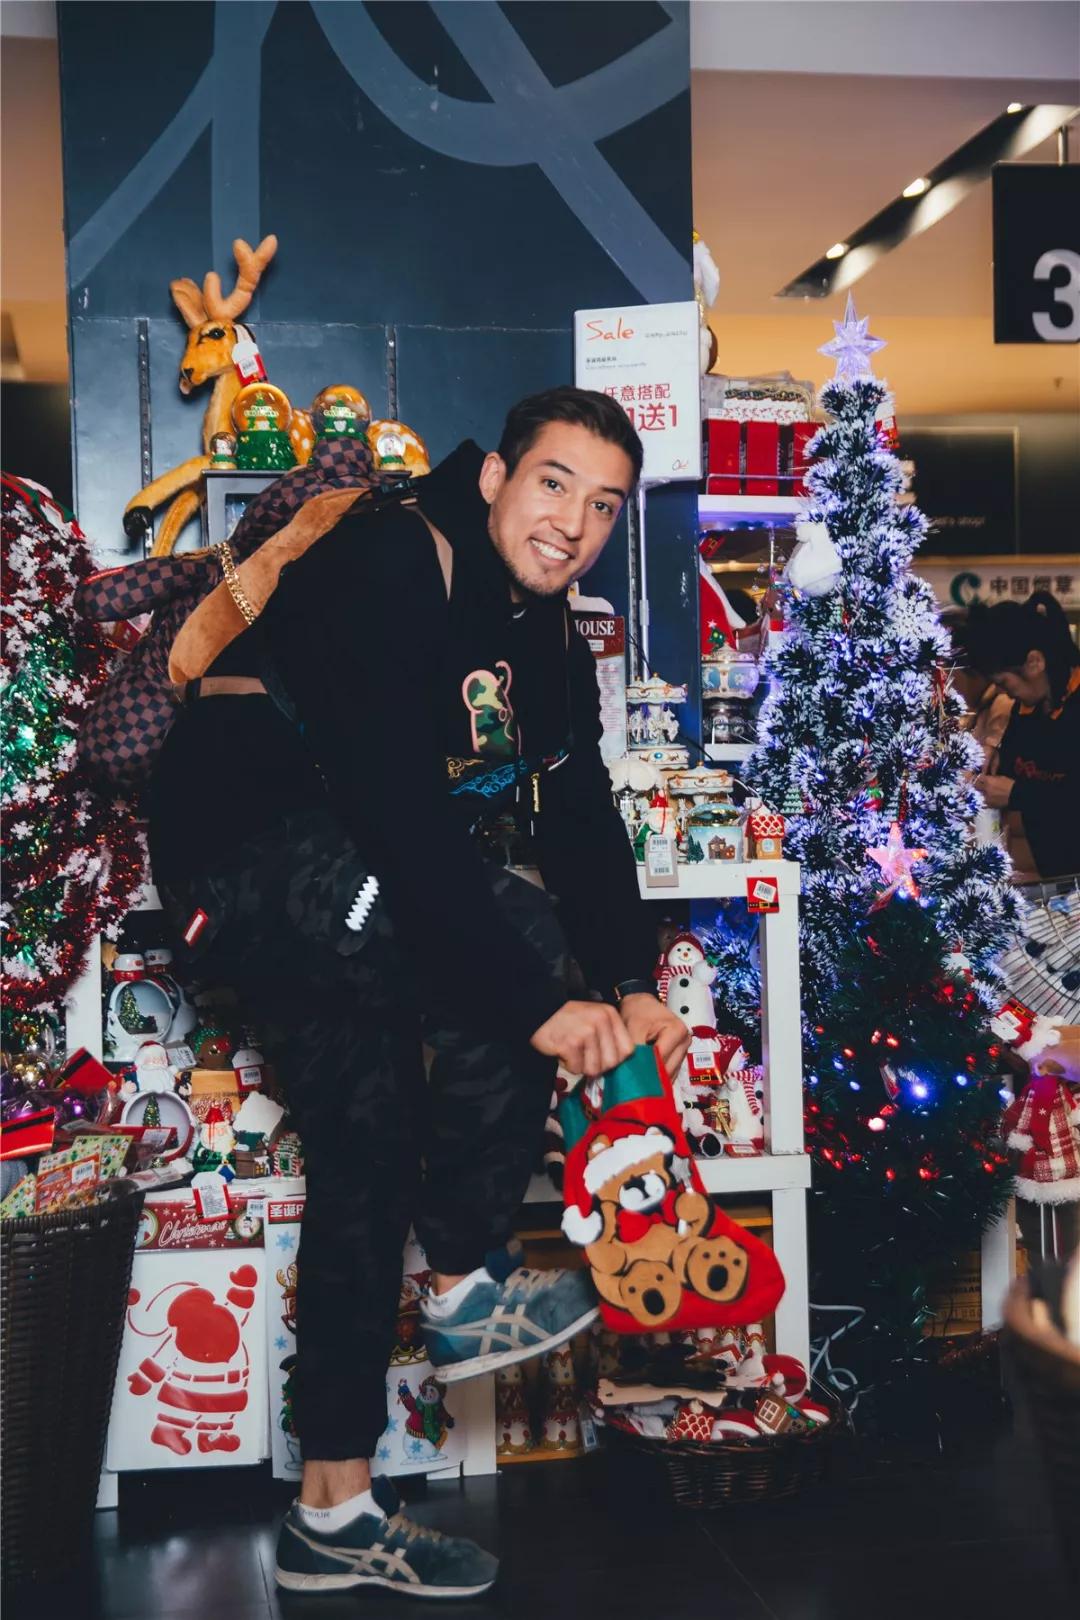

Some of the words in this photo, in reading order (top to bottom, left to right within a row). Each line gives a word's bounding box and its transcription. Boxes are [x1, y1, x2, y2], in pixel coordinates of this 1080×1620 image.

[1032, 249, 1080, 341] 3
[586, 316, 634, 341] Sale
[602, 383, 671, 402] 任意搭配
